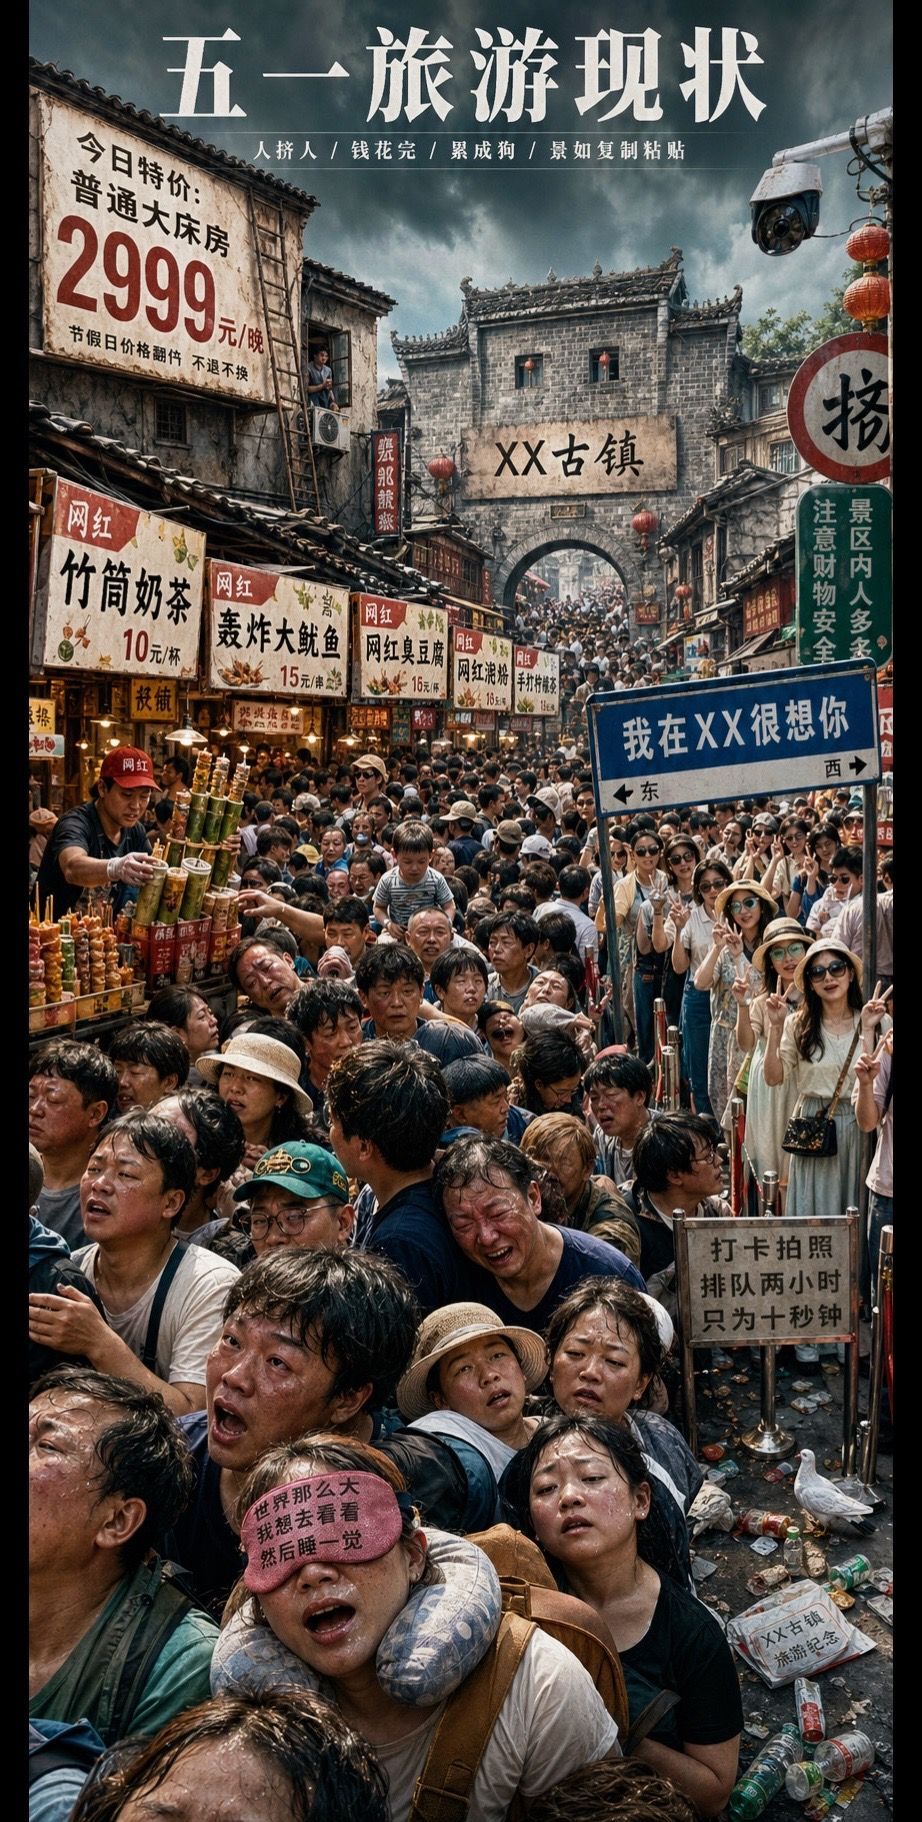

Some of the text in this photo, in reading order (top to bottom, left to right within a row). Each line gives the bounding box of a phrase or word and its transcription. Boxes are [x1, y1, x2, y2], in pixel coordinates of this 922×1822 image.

[70, 169, 231, 258] 普通大床房
[191, 354, 249, 382] 不退不换
[494, 429, 644, 478] XX古镇
[66, 500, 113, 539] 网红
[59, 548, 193, 626] 竹筒奶茶
[216, 571, 254, 598] 网红
[812, 498, 837, 663] 注意财物安全
[365, 602, 393, 625] 网红
[122, 627, 181, 666] 10元/杯
[216, 607, 342, 660] 轰炸大鱿鱼
[366, 633, 445, 669] 网红臭豆腐
[456, 632, 475, 651] 网红
[516, 650, 531, 666] 网红
[279, 664, 325, 690] 15元/串
[622, 695, 850, 763] 我在XX很想你
[122, 757, 149, 773] 网红
[823, 758, 842, 778] 西
[640, 780, 660, 802] 东
[710, 1235, 834, 1263] 打卡拍照
[700, 1269, 842, 1299] 排队两小时
[702, 1303, 843, 1333] 只为十秒钟
[253, 1476, 361, 1523] 世界那么大
[256, 1501, 361, 1546] 我想去看看
[260, 1529, 364, 1571] 然后睡一觉
[760, 1609, 825, 1649] XX古镇
[774, 1630, 840, 1668] 旅游纪念
